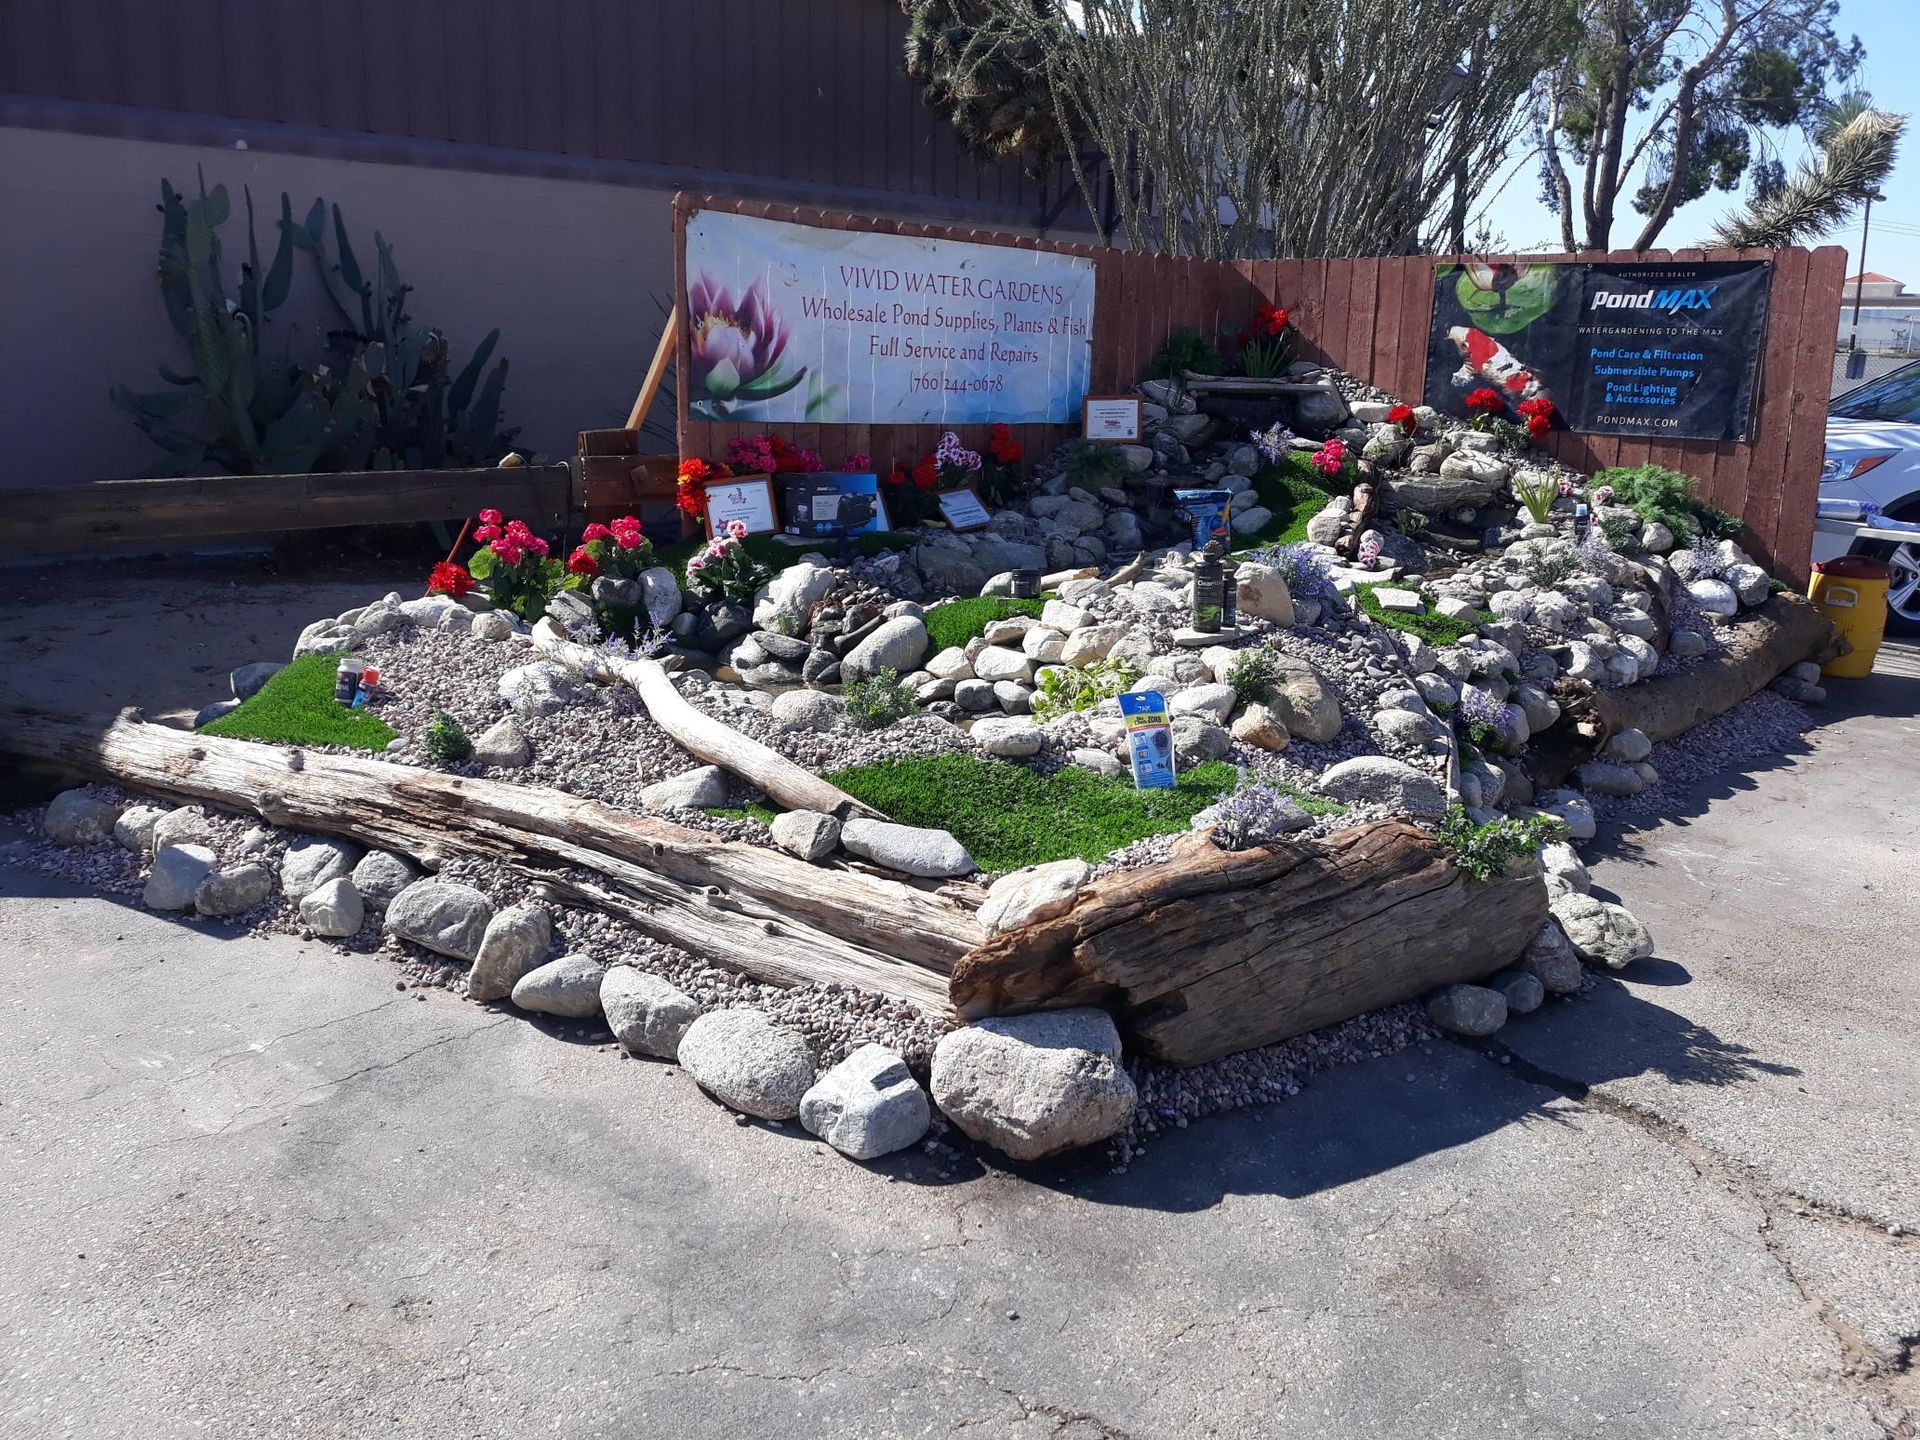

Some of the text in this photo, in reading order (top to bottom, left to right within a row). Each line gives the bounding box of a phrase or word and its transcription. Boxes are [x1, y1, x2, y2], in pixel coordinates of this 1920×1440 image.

[840, 266, 1063, 304] VIVID WATER GARDENS
[1590, 283, 1719, 315] PondMAX
[801, 297, 1086, 335] Wholesale Pond Supplies, Plants & Fish
[1578, 327, 1662, 335] WATERGARDENING
[870, 336, 1038, 366] Full Service and Repairs
[1590, 348, 1703, 361] Pond Care & Filtration
[1594, 365, 1694, 380] Submersible Pumps
[1607, 382, 1677, 396] Pond Lighting
[1605, 393, 1676, 405] & Accessories
[1597, 416, 1678, 427] PONDMAX.COM
